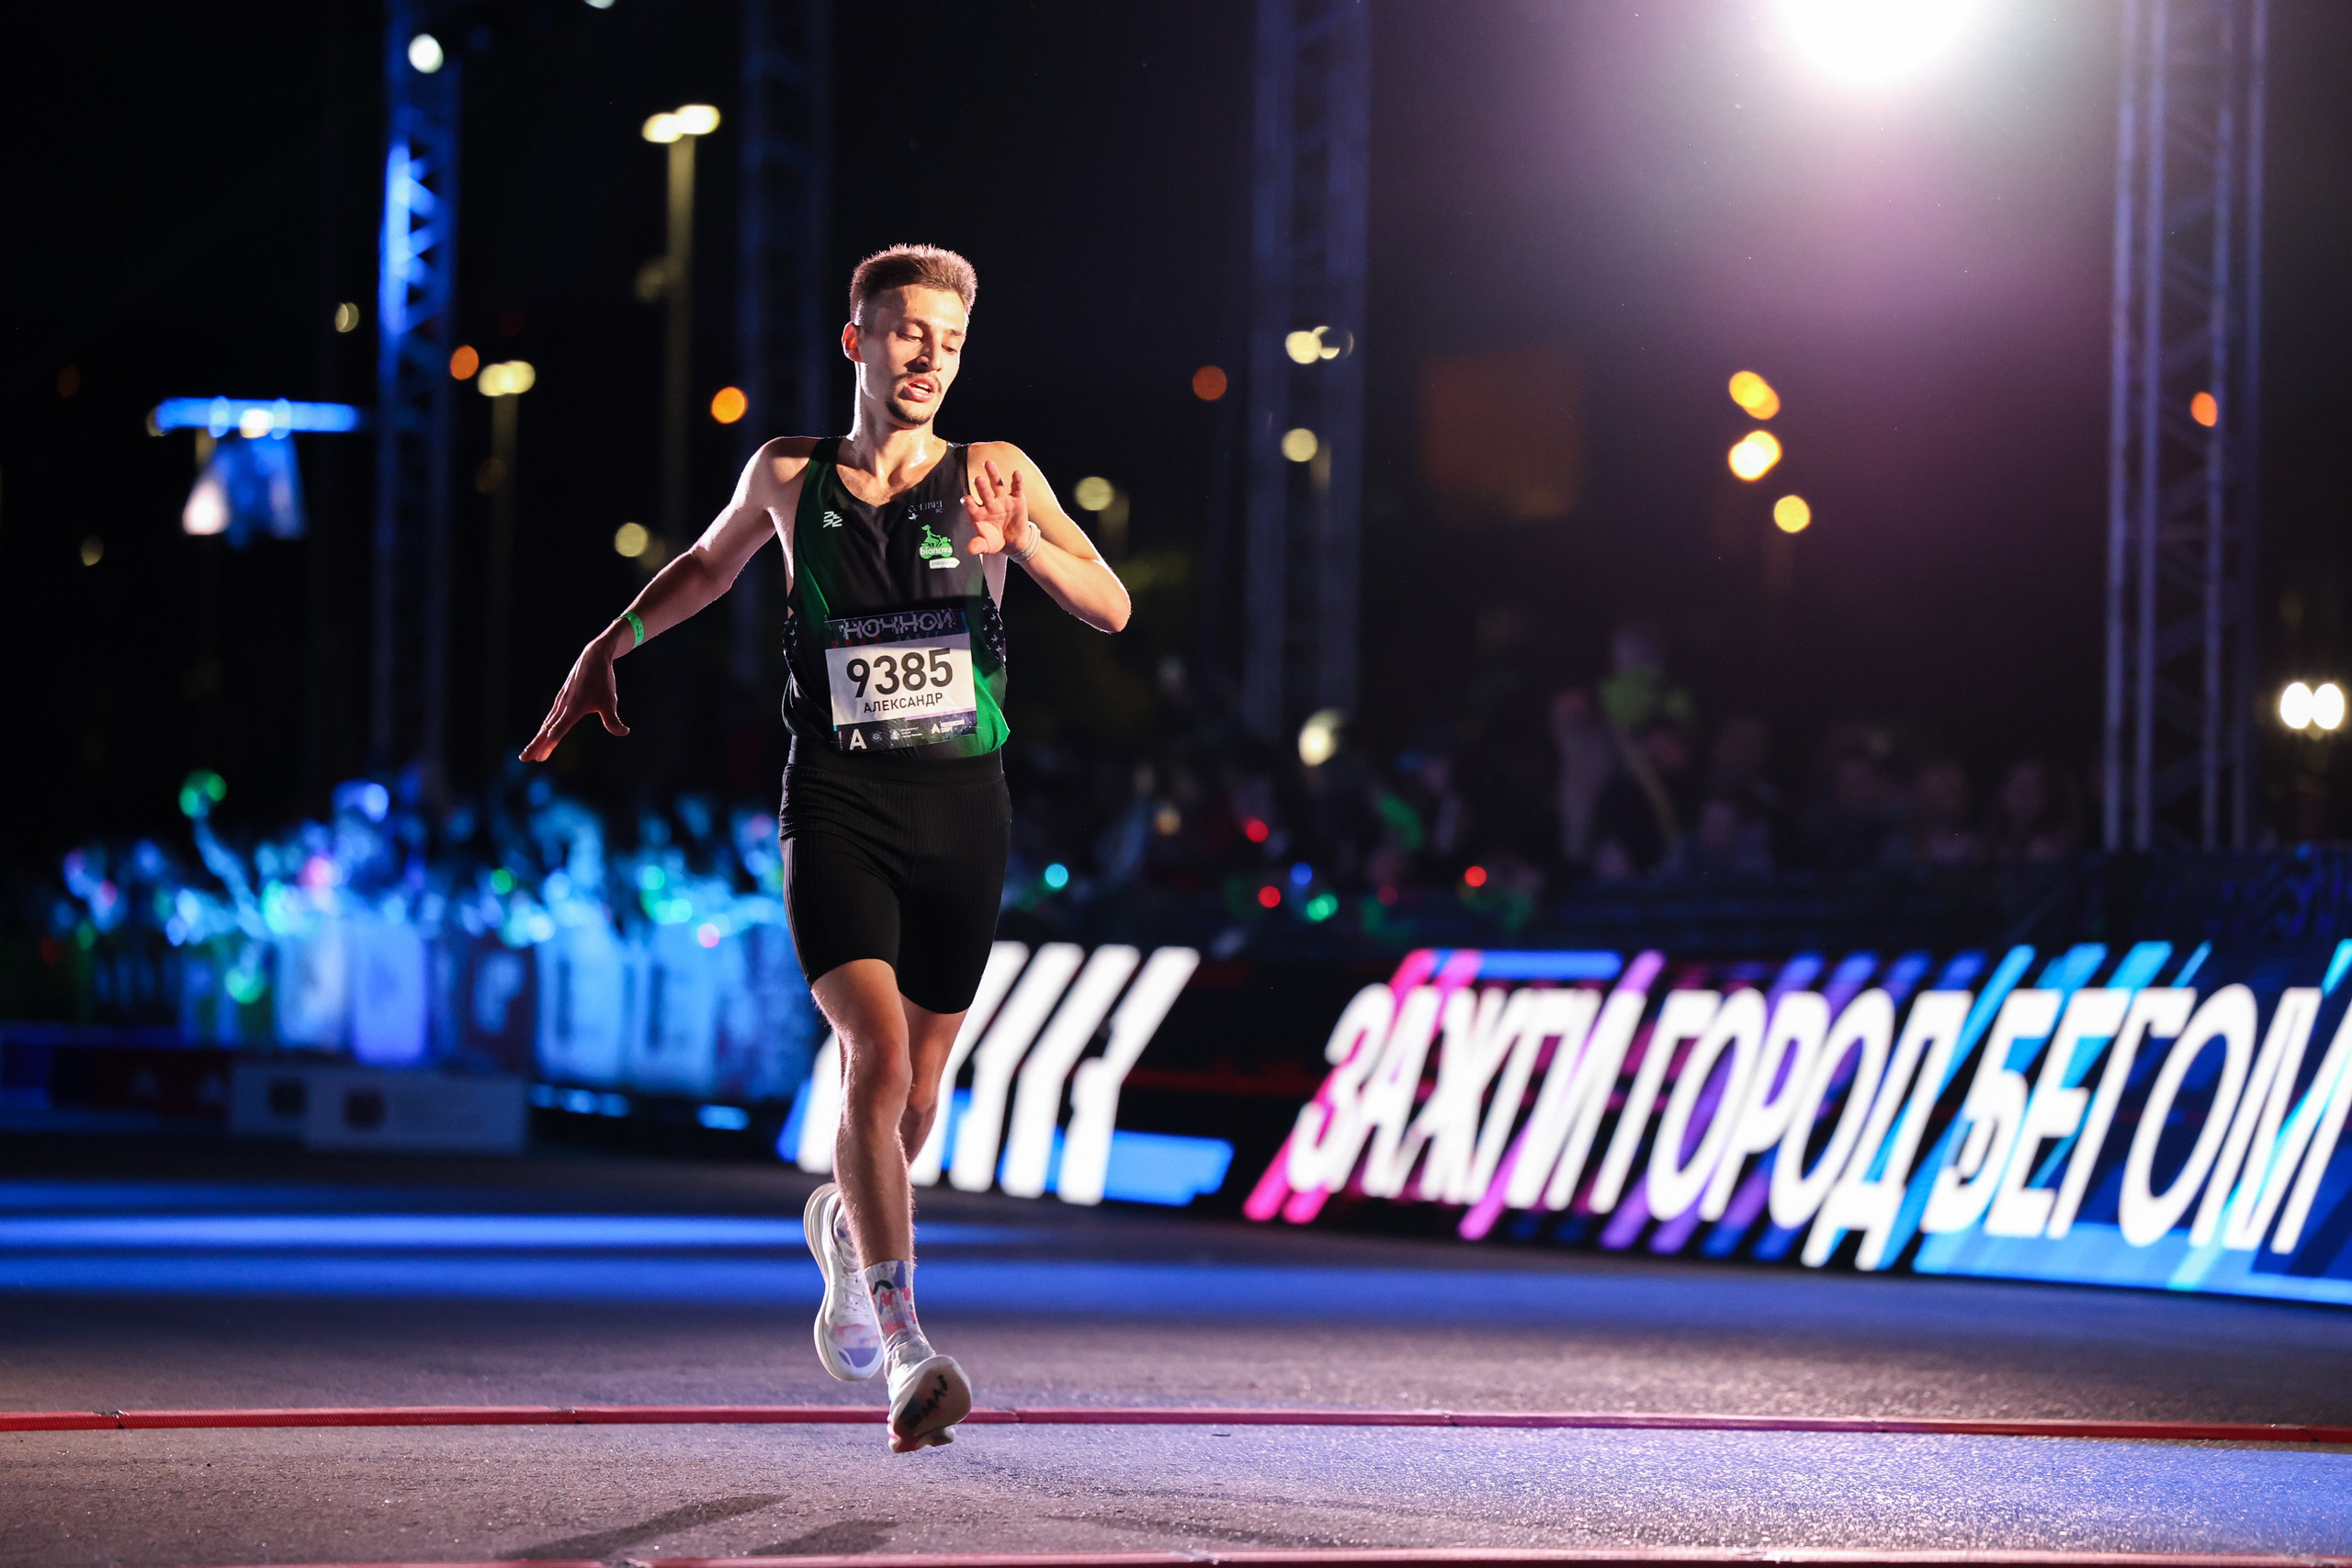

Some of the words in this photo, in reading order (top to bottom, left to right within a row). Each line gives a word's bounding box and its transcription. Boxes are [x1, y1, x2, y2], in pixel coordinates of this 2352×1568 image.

[920, 547, 953, 555] bionova
[839, 609, 956, 639] НОЧНОЙ
[846, 648, 953, 699] 9385
[864, 693, 944, 714] АЛЕКСАНДР
[849, 728, 867, 750] A
[1589, 987, 1973, 1270] ГОРОД
[1919, 984, 2352, 1254] БЕГОМ
